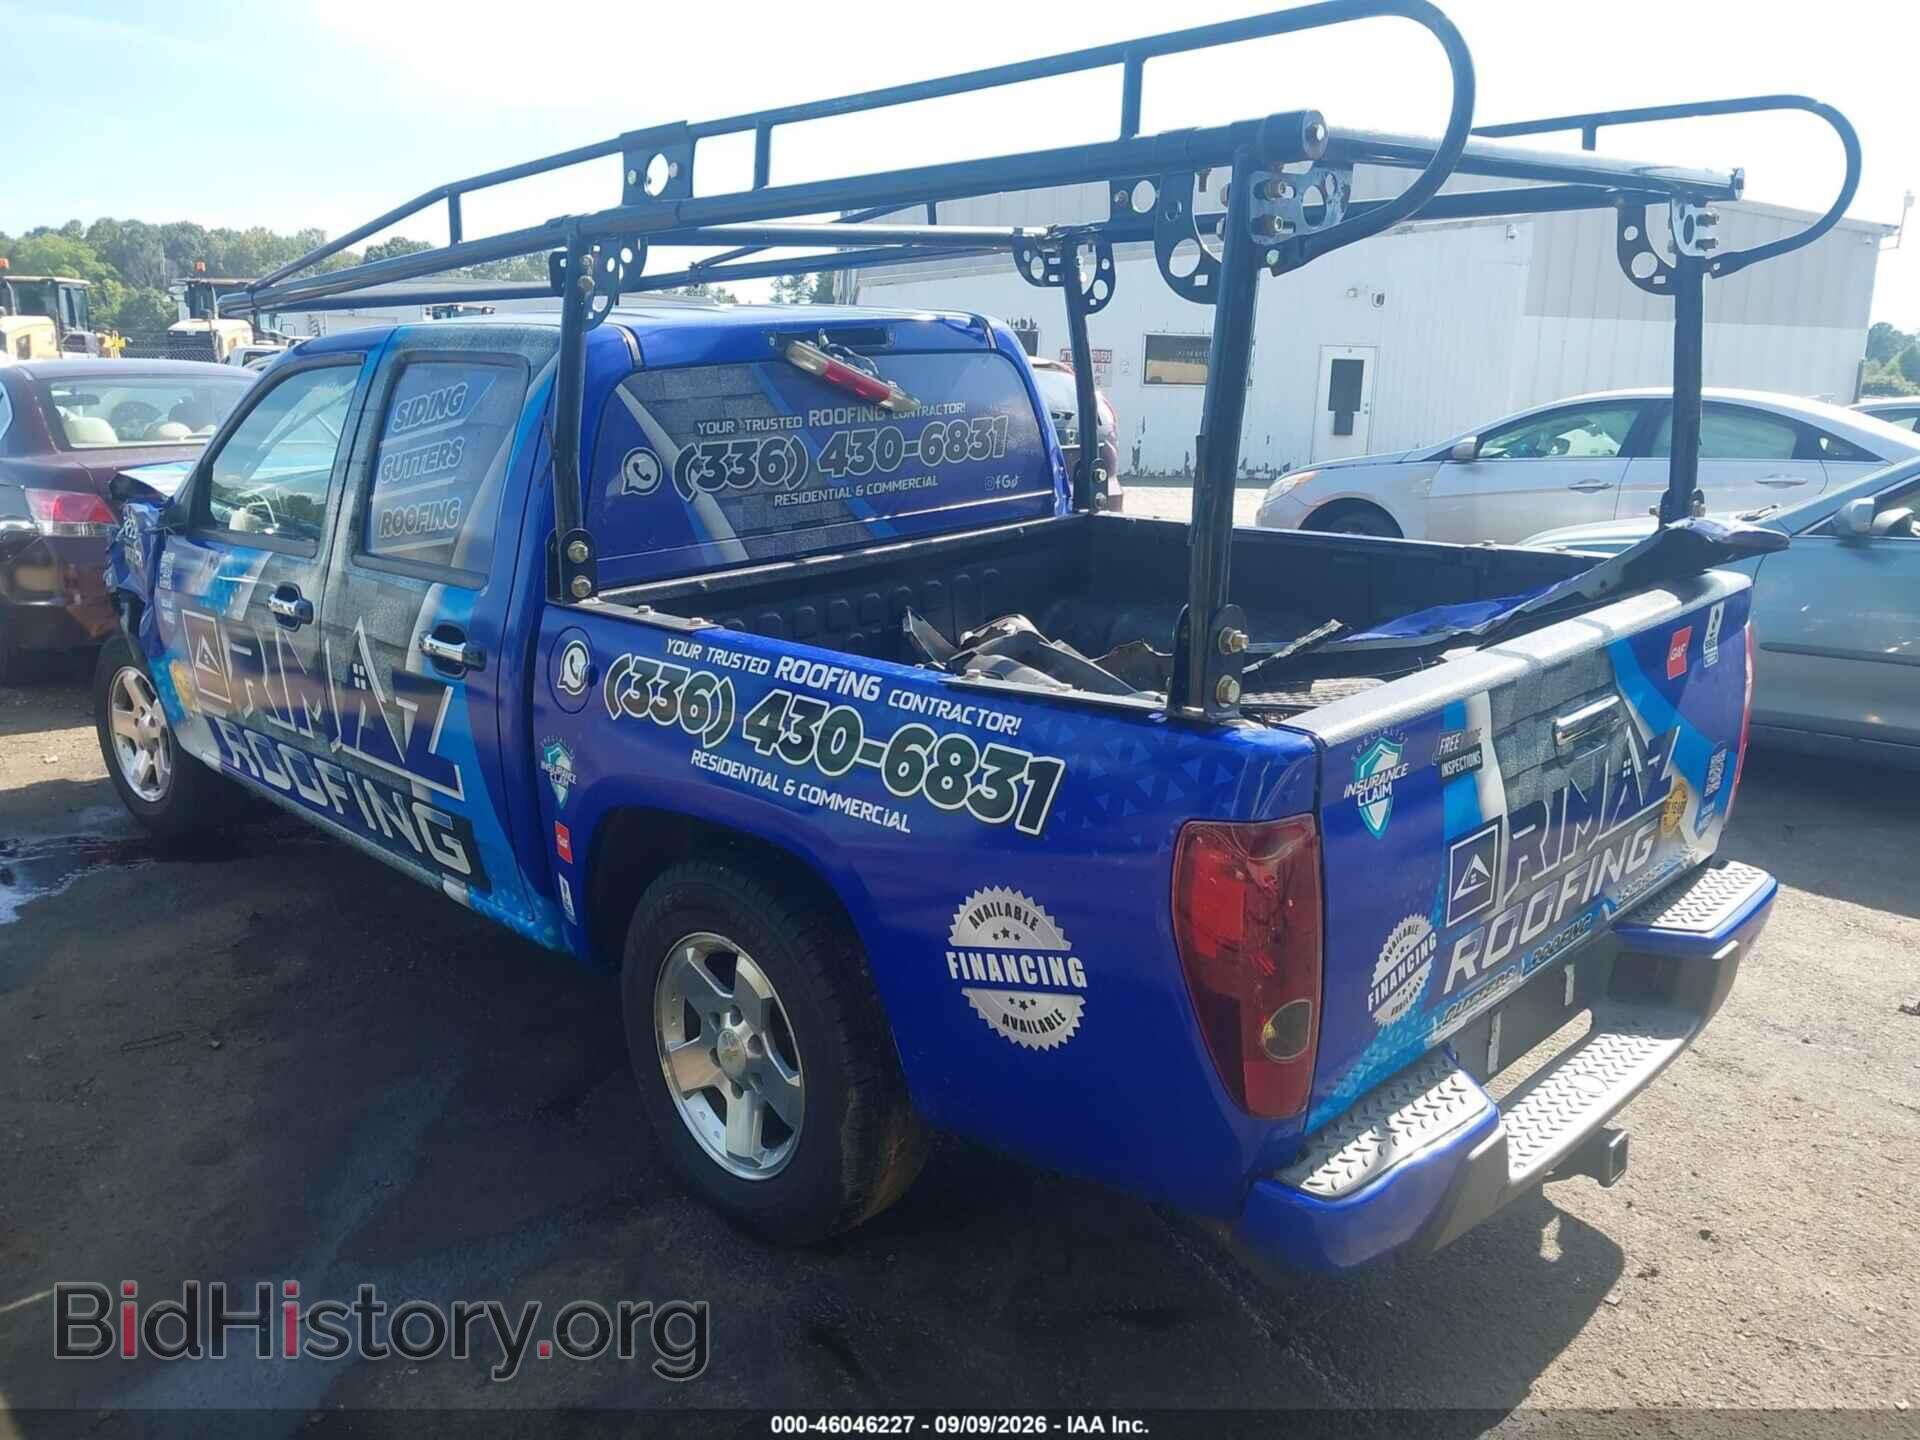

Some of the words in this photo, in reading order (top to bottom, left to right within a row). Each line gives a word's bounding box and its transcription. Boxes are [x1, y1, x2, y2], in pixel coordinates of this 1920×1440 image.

[392, 382, 468, 432] SIDING
[698, 420, 735, 435] YOUR
[744, 417, 802, 432] TRUSTED
[809, 407, 885, 427] ROOFING
[380, 436, 464, 483] GUTTERS
[673, 436, 808, 503] (336)
[817, 416, 1008, 478] 430-6831
[774, 488, 852, 507] RESIDENTIAL
[855, 485, 864, 497] &
[866, 475, 938, 495] COMMERCIAL
[378, 497, 462, 538] ROOFING
[666, 638, 703, 660] YOUR
[707, 647, 771, 676] TRUSTED
[888, 689, 1022, 736] CONTRACTOR!
[604, 654, 735, 748] (336)
[743, 689, 1066, 836] 430-6831
[1439, 733, 1463, 756] FREE
[1344, 763, 1410, 799] INSURANCE
[1441, 750, 1482, 778] INSPECTIONS
[214, 716, 471, 875] ROOFING
[783, 779, 795, 796] &
[1357, 782, 1393, 807] CLAIM
[968, 901, 1039, 931] AVAILABLE
[1444, 816, 1660, 994] ROOFING
[945, 951, 1088, 988] FINANCING
[1367, 931, 1437, 1012] FINANCING
[1002, 1008, 1066, 1034] AVAILABLE
